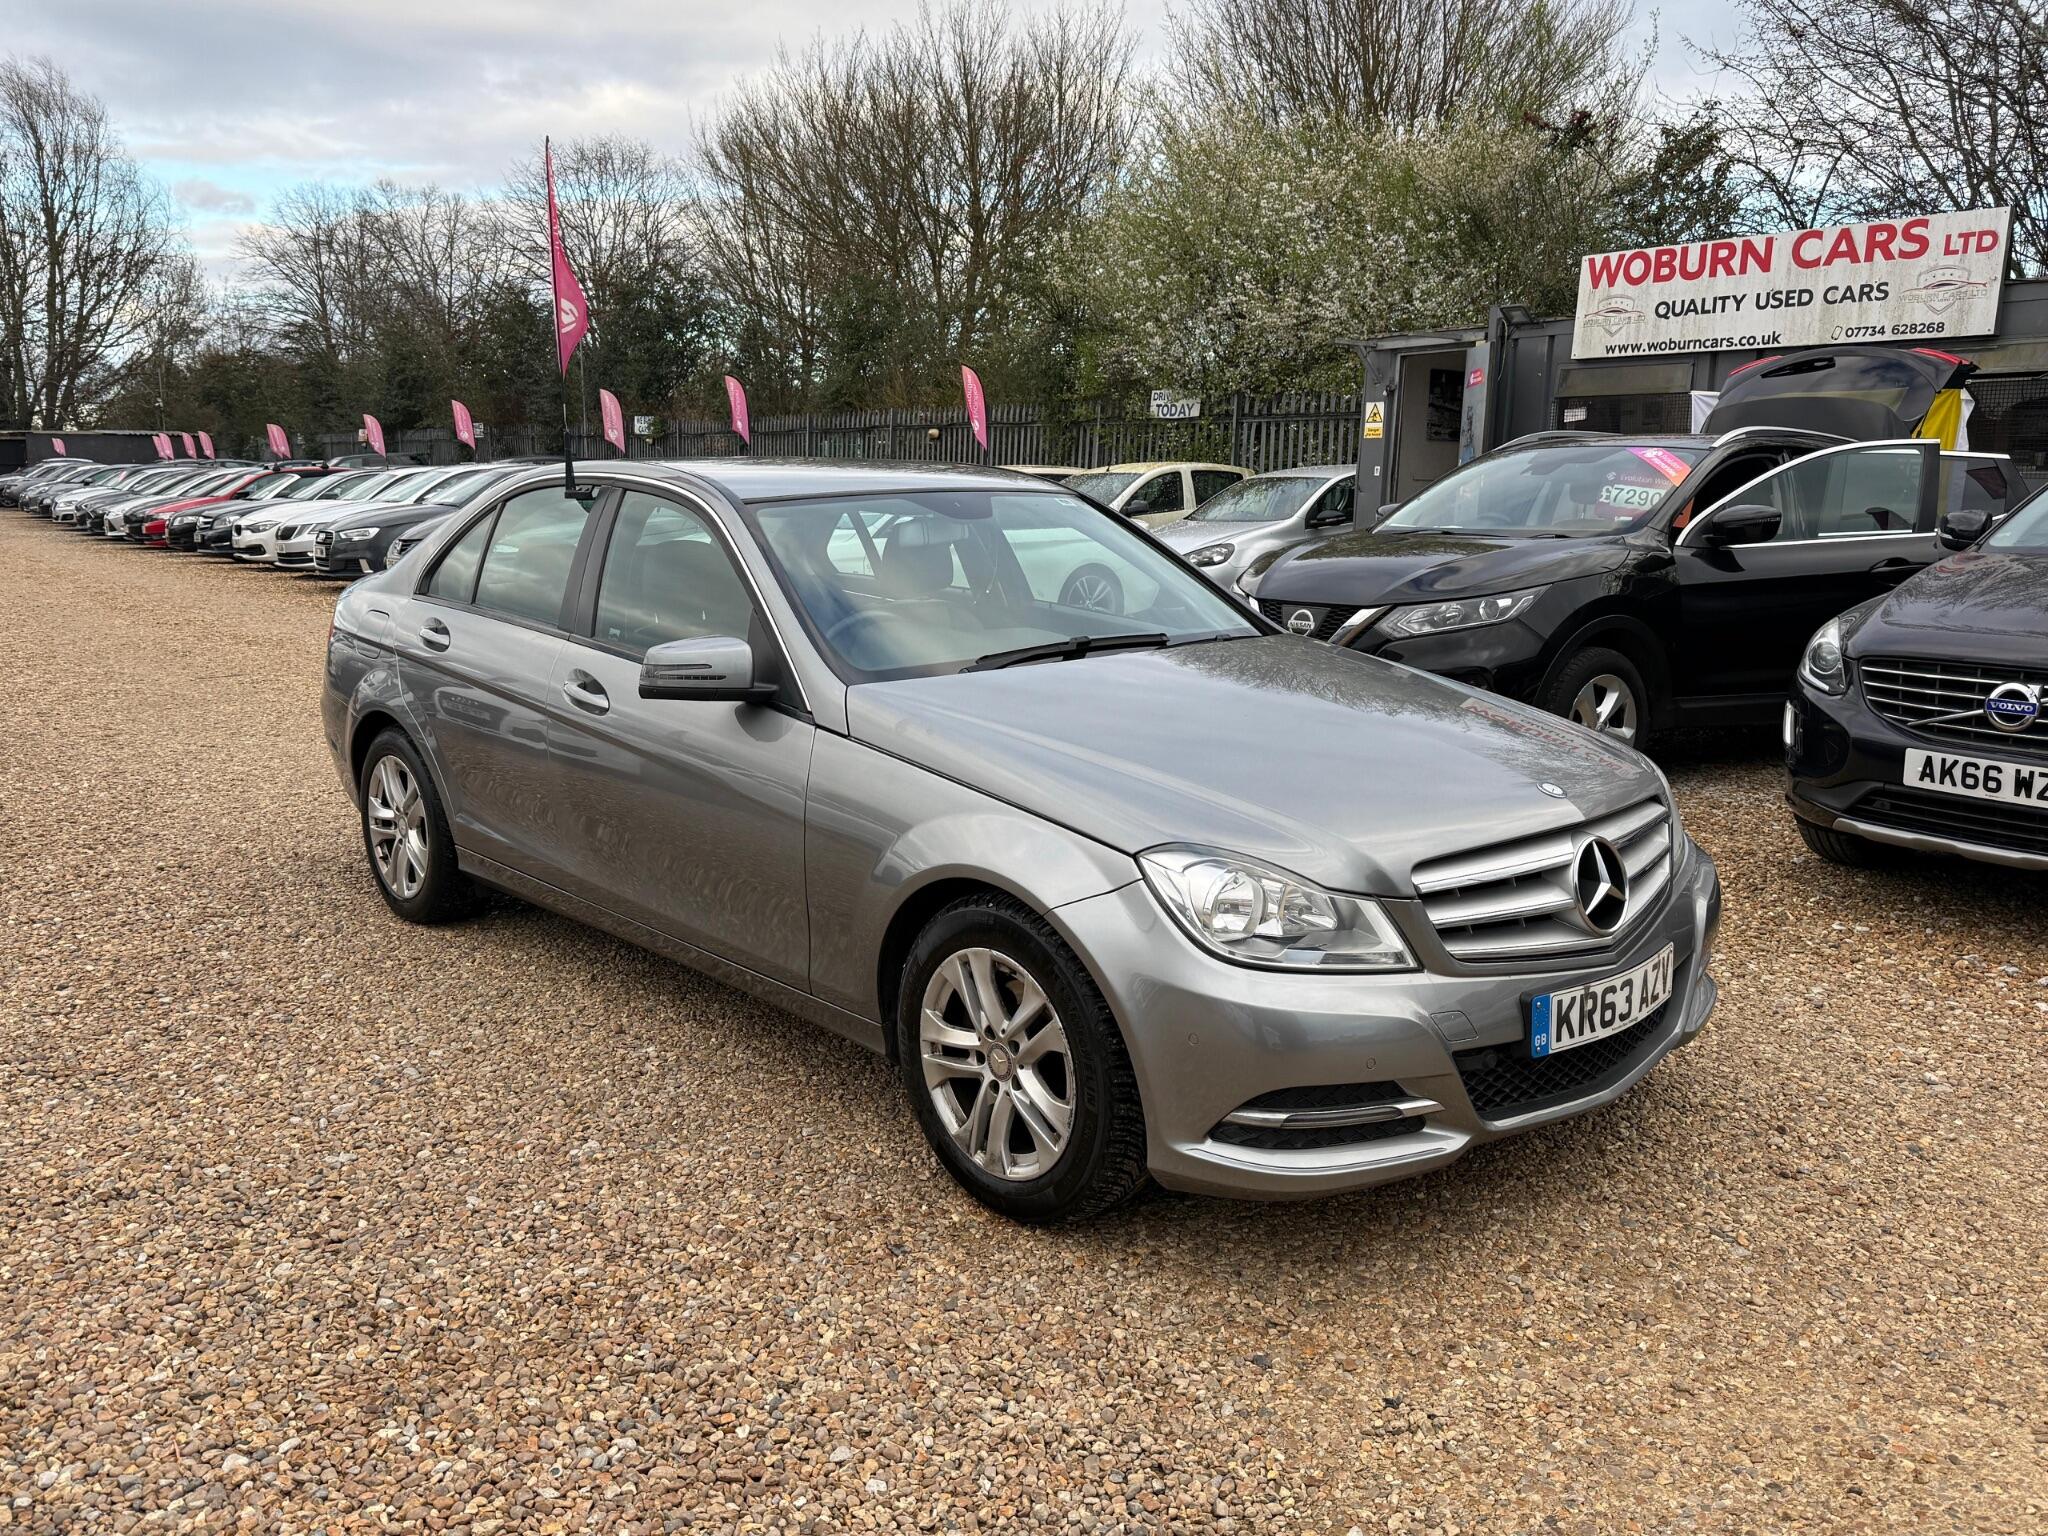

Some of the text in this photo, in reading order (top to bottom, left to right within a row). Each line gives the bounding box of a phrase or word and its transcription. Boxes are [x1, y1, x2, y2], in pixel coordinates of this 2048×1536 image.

[1588, 218, 1999, 289] WOBURN CARS LTD
[1655, 282, 1889, 319] QUALITY USED CARS
[1845, 322, 1945, 338] 07734 628268
[1605, 331, 1781, 355] www.woburncars.co.uk
[1156, 403, 1194, 417] TODAY
[1989, 701, 2034, 712] VOLVO
[1919, 755, 2003, 793] AK66
[1556, 952, 1671, 1043] KR63 AZV
[1535, 1033, 1546, 1046] GB
